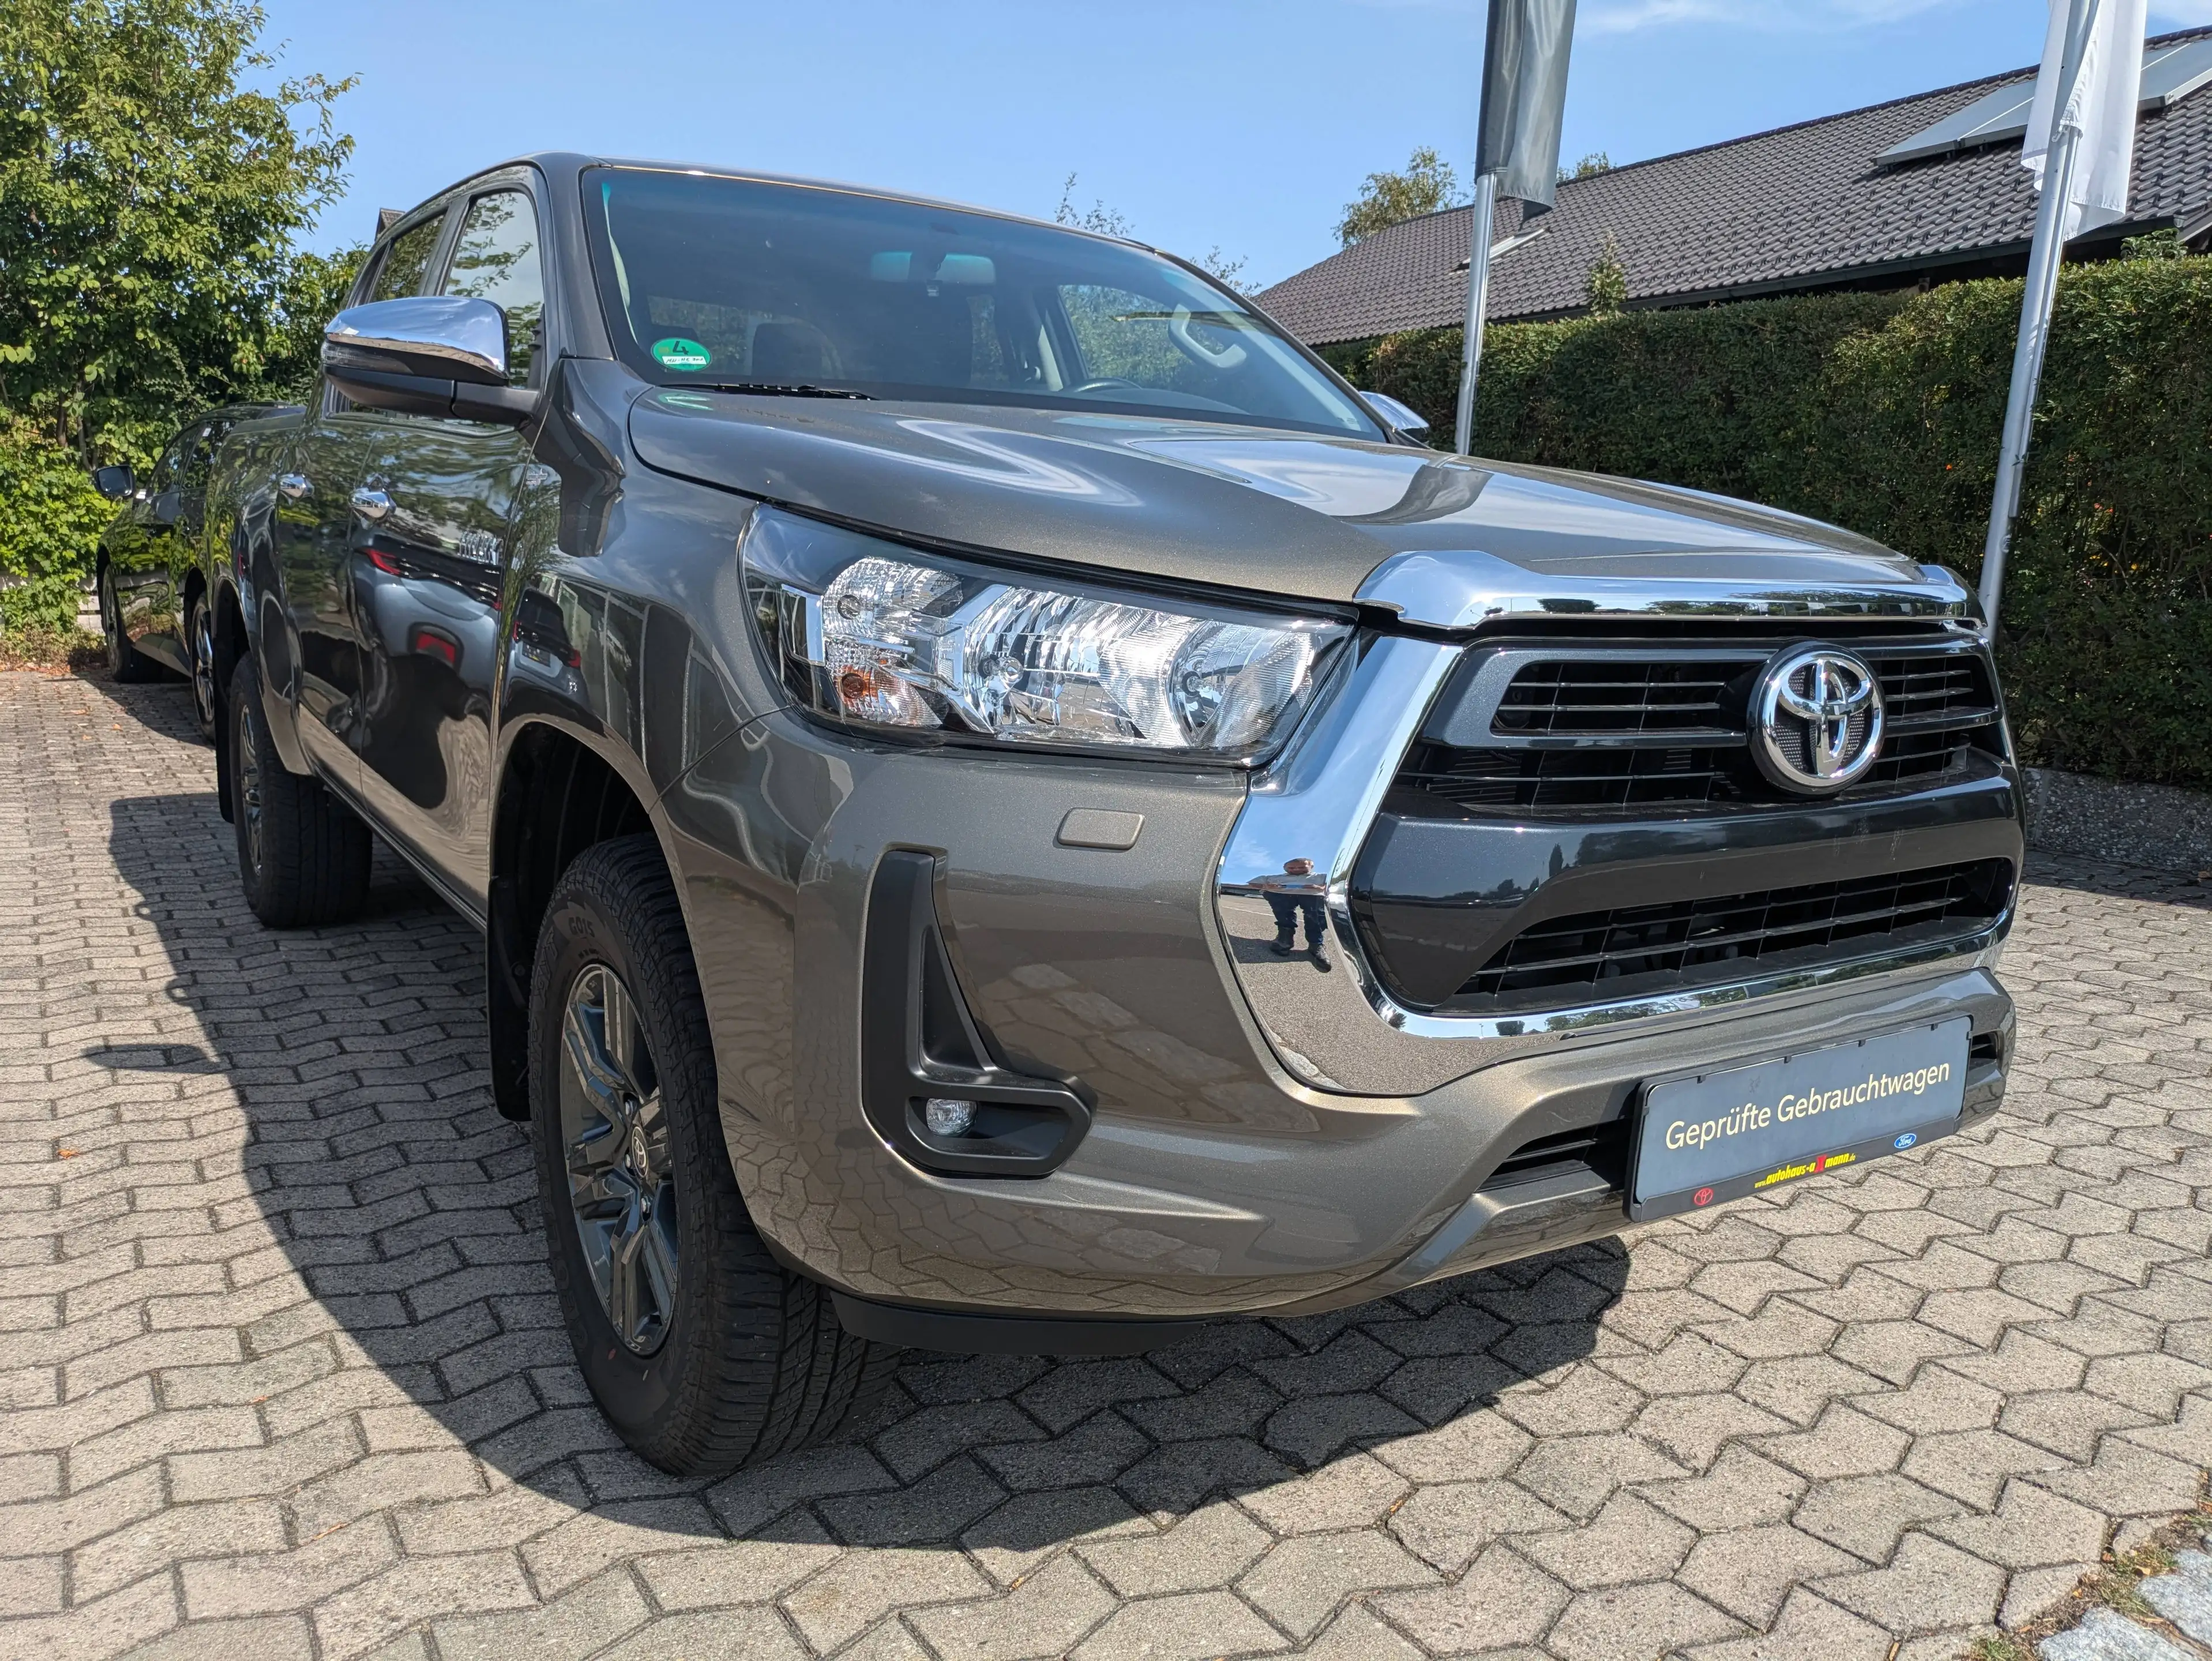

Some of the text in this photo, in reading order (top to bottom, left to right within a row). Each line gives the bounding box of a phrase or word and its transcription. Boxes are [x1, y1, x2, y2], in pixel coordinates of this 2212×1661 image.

[672, 340, 689, 355] 4
[568, 916, 595, 938] G015
[1665, 1062, 1950, 1150] Geprüfte Gebrauchtwagen
[1897, 1134, 1914, 1147] Ford
